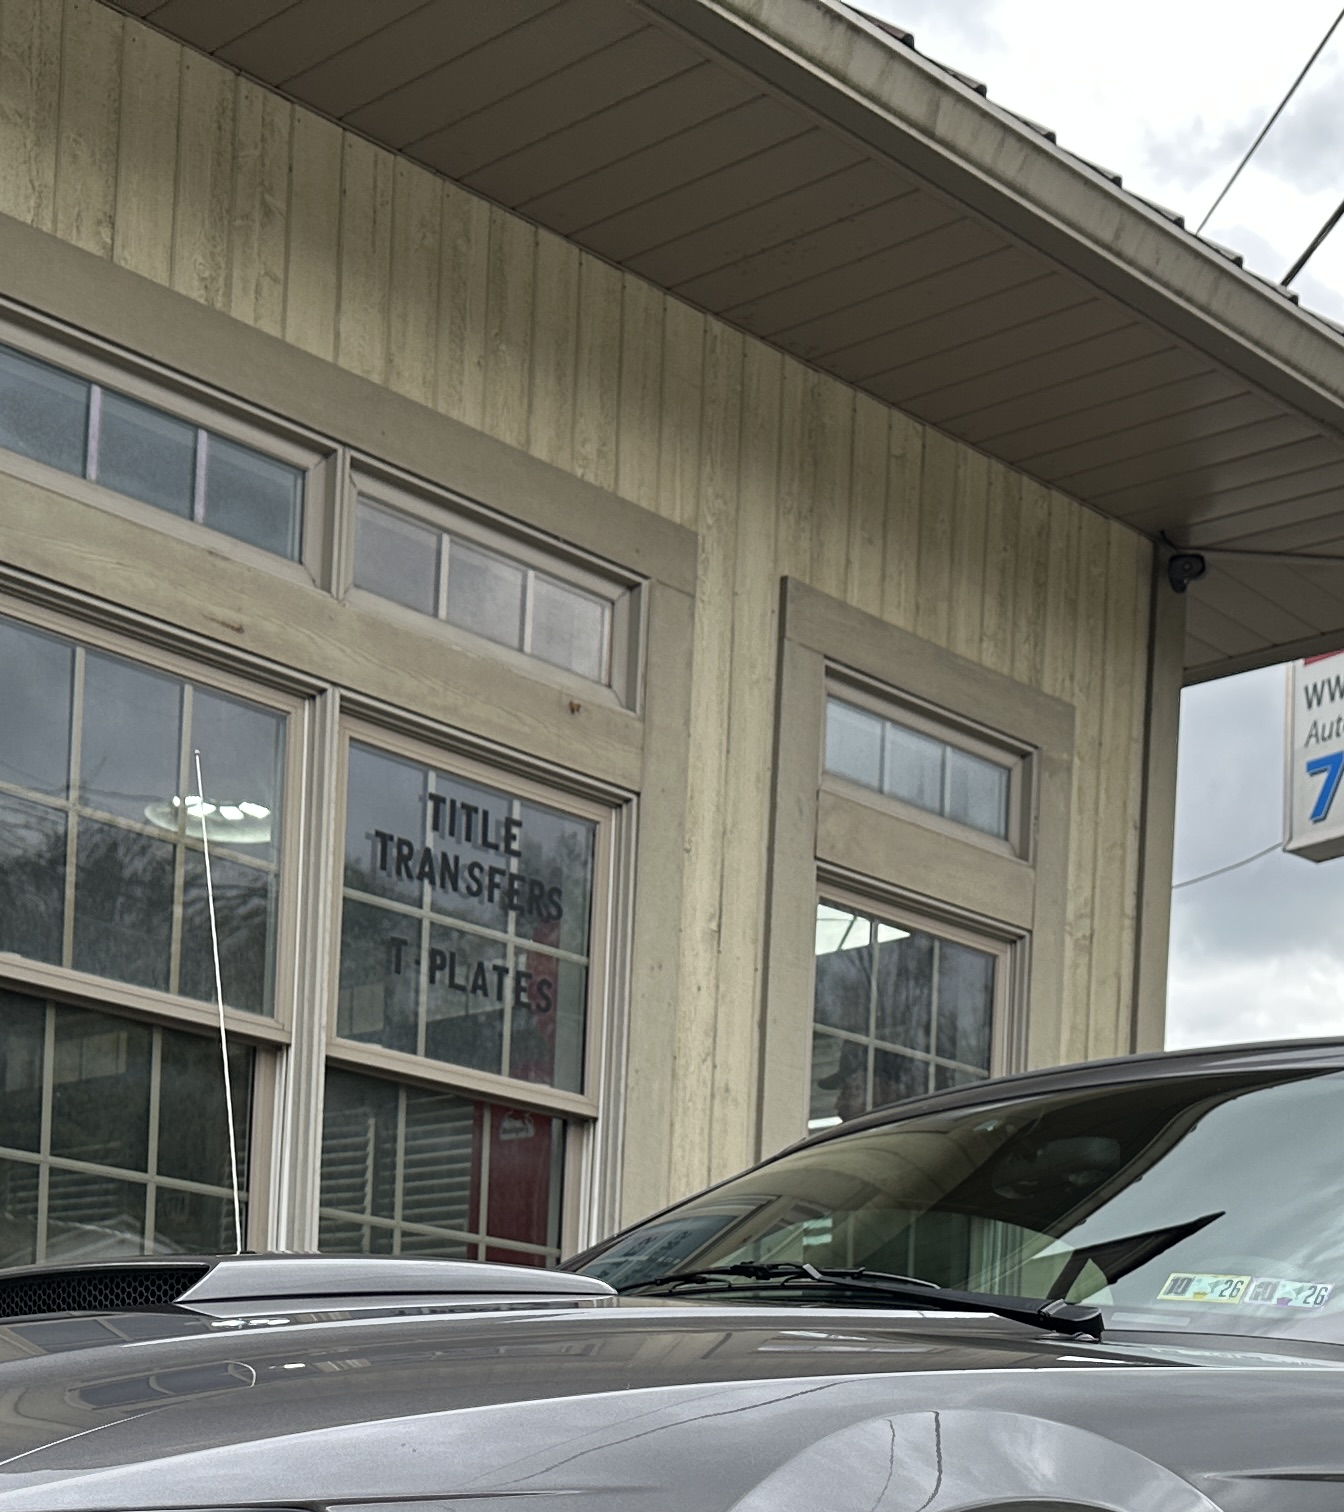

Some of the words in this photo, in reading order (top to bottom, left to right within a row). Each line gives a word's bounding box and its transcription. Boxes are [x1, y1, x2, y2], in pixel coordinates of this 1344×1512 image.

[428, 792, 523, 858] TITLE
[374, 829, 564, 922] TRANSFERS
[1218, 1279, 1244, 1299] 26
[1302, 1286, 1329, 1306] 26
